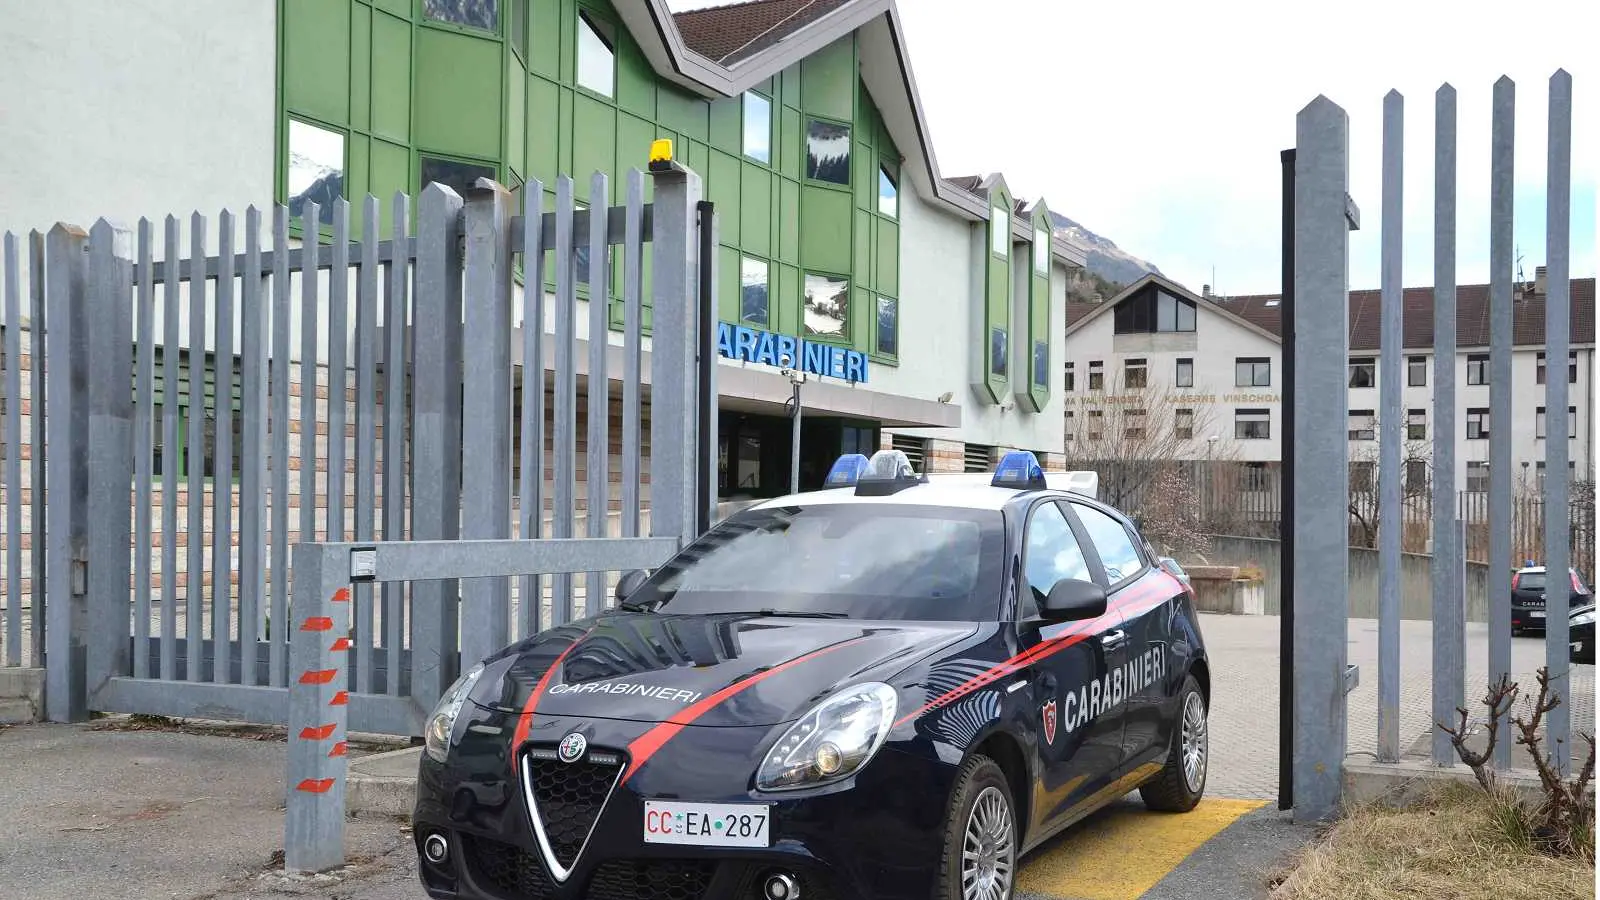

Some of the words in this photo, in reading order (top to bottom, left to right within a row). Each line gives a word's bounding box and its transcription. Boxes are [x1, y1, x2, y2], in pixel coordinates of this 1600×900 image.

[718, 321, 868, 383] ARABNIERI
[1223, 394, 1280, 403] VINSCHGA
[549, 683, 702, 703] CARABINIERI
[1064, 643, 1166, 733] CARABINIERI
[647, 810, 672, 834] CC
[686, 812, 712, 837] EA
[725, 814, 766, 838] 287
